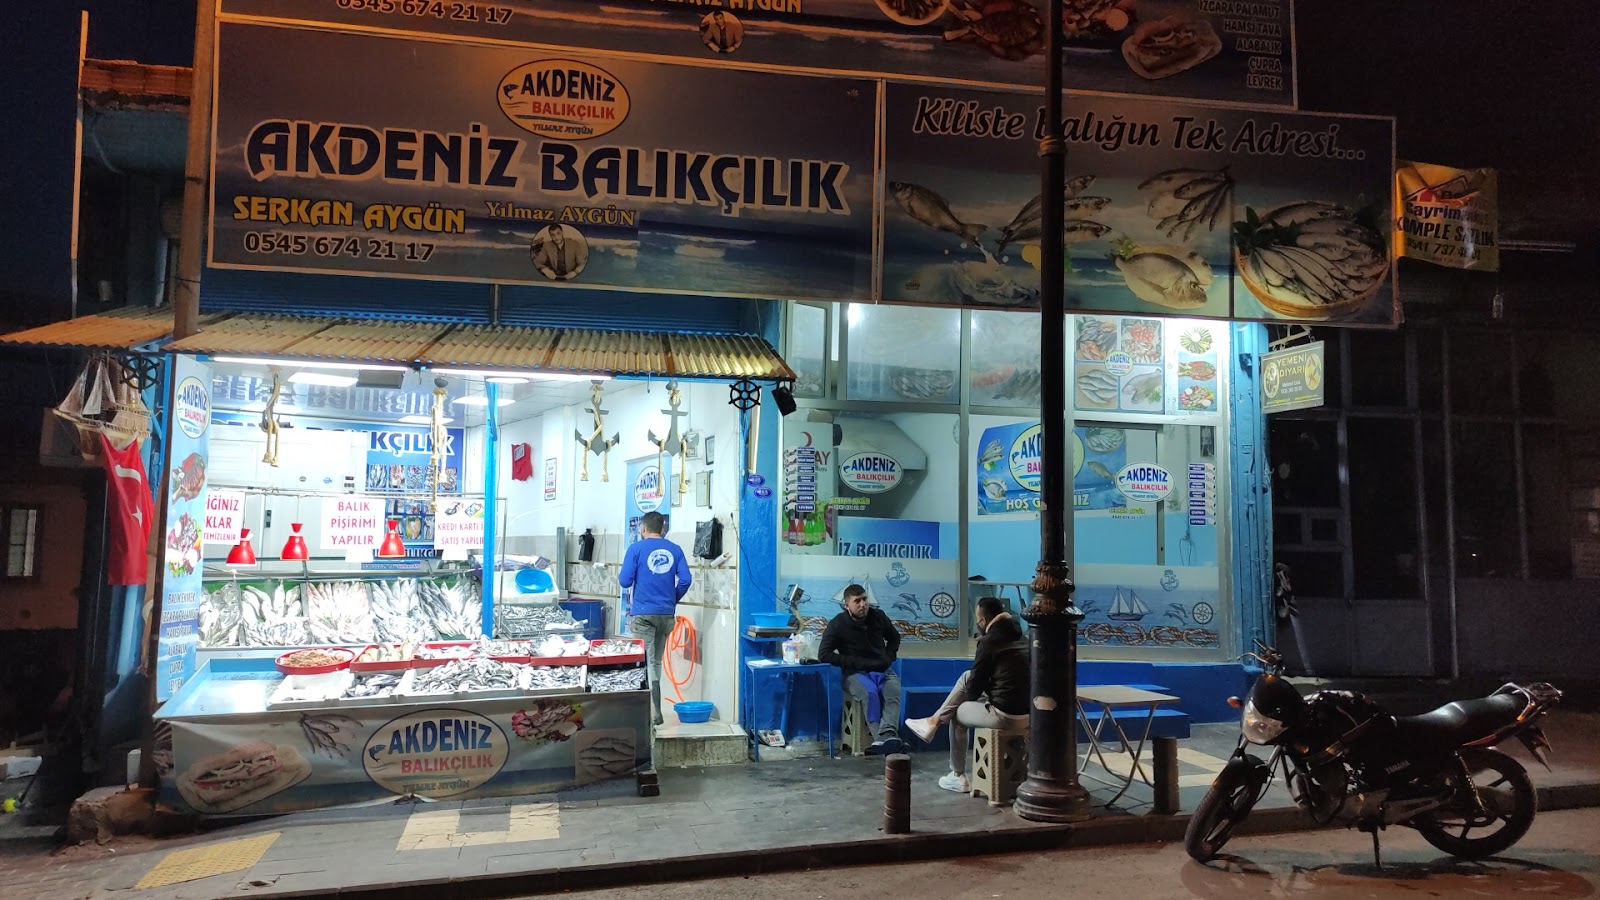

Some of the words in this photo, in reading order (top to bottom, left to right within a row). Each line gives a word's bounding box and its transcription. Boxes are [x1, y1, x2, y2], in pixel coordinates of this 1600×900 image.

[402, 0, 444, 16] 674
[451, 3, 478, 20] 21
[486, 7, 512, 23] 17
[1236, 3, 1280, 17] PALAMUT
[1224, 18, 1255, 32] HAMSİ
[1258, 25, 1281, 37] TAVA
[1236, 39, 1281, 54] ALABALIK
[1249, 57, 1281, 72] ÇUPRA
[521, 69, 616, 102] AKDENİZ
[1247, 74, 1282, 90] LEVREK
[532, 101, 616, 120] BALIKÇILIK
[914, 97, 1025, 139] Kiliste
[1172, 116, 1224, 151] Tek
[1231, 120, 1366, 161] Adresi...
[246, 123, 520, 188] AKDENİZ
[539, 141, 845, 216] BALIKÇILIK
[233, 195, 353, 226] SERKAN
[363, 201, 466, 233] AYGÜN
[486, 201, 555, 221] Yılmaz
[558, 204, 637, 226] AYGÜN
[244, 232, 307, 254] 0545
[314, 235, 360, 257] 674
[367, 240, 397, 259] 21
[405, 242, 435, 261] 17
[1434, 242, 1456, 256] 737
[851, 456, 896, 472] AKDENİZ
[856, 473, 896, 482] BALIKÇILIK
[1126, 467, 1168, 483] AKDENİZ
[1131, 483, 1168, 491] BALIKÇILIK
[338, 501, 370, 512] BALIK
[1006, 498, 1029, 511] HOŞ
[205, 516, 232, 529] KLAR
[331, 516, 376, 530] PİŞİRİMİ
[331, 535, 374, 545] YAPILIR
[387, 718, 493, 754] AKDENİZ
[401, 754, 494, 774] BALIKÇILIK
